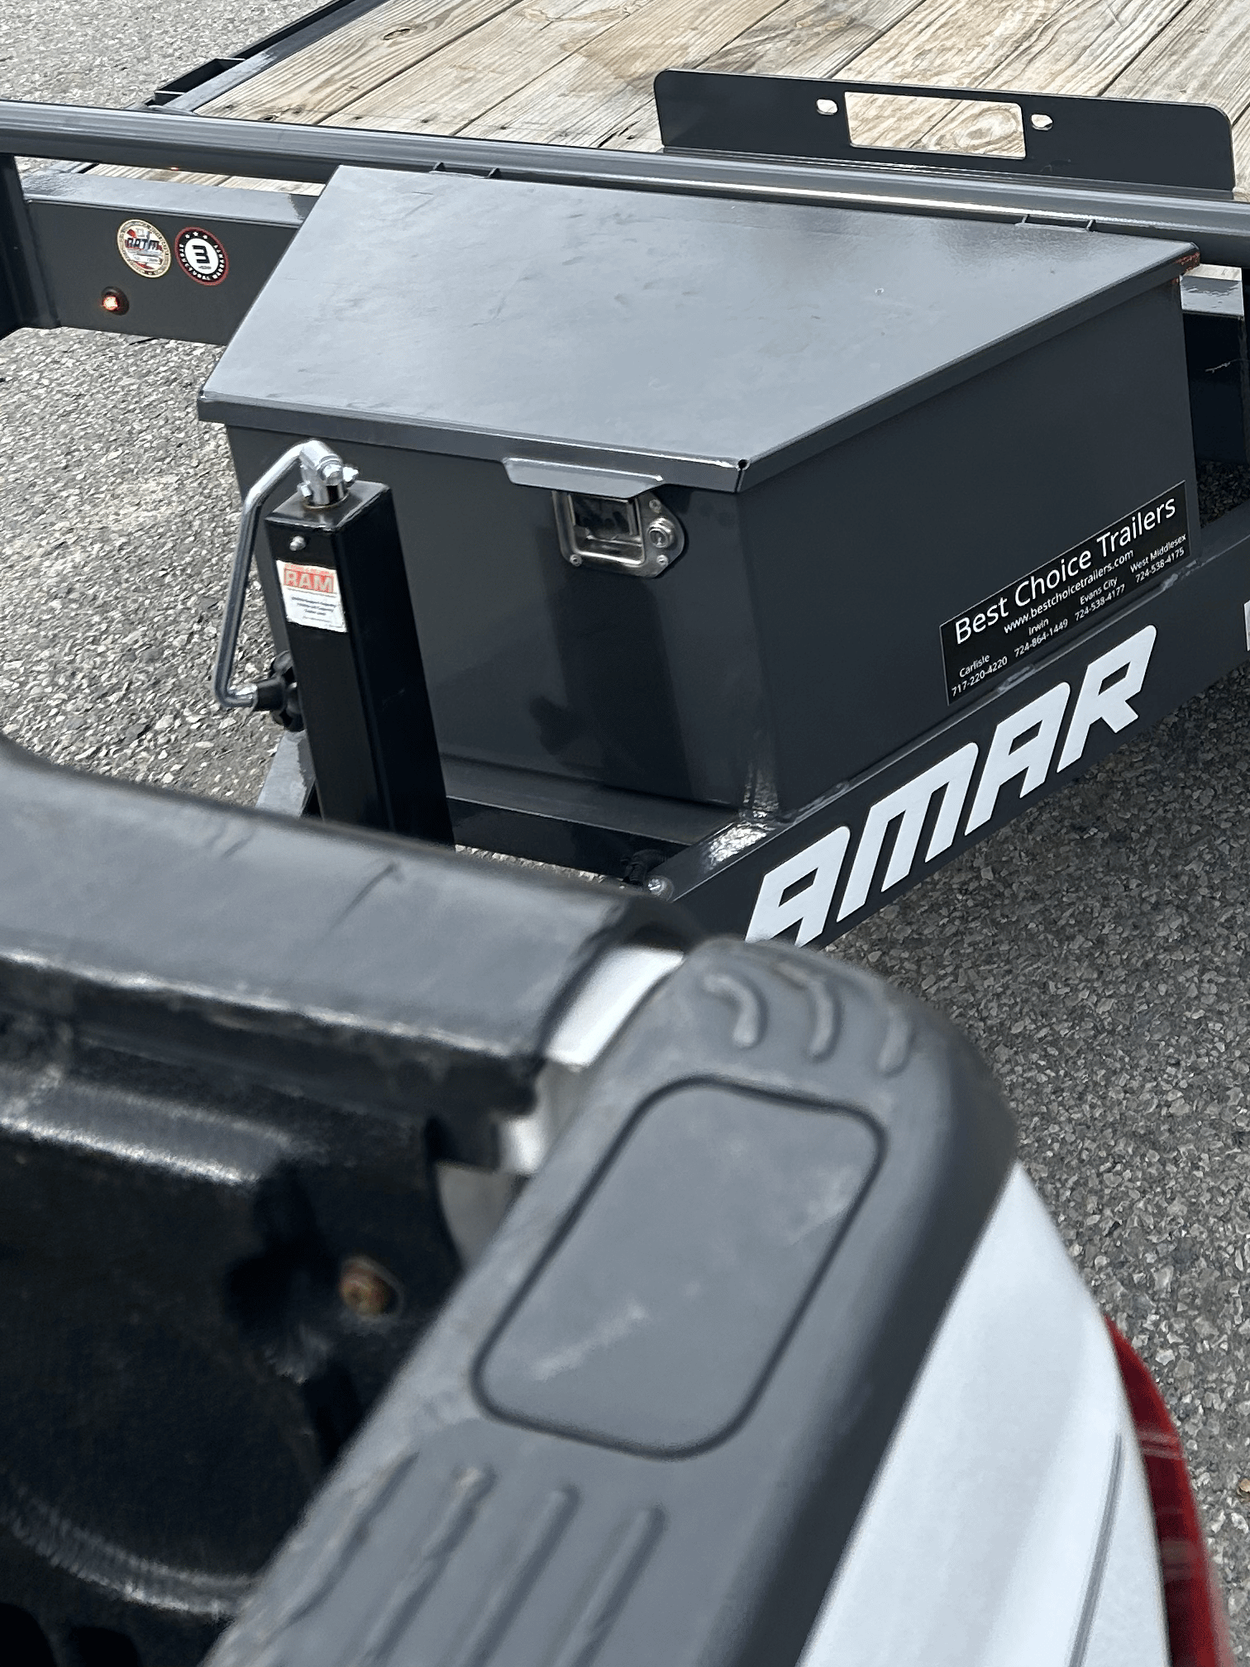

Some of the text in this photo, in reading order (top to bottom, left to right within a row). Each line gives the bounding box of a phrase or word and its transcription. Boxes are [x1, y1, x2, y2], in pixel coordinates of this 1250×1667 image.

[192, 245, 210, 264] 3
[954, 497, 1177, 645] Best Choice Trailers
[1129, 534, 1187, 574] West Middlesex
[1135, 547, 1185, 583] 724-538-4175
[286, 570, 334, 593] RAM
[1003, 549, 1135, 634] www.bestchoicetrailers.com
[1079, 576, 1119, 605] Evans City
[1074, 583, 1126, 622] 724-538-4177
[1013, 618, 1069, 657] 724-864-1449
[1028, 617, 1050, 636] Irwin
[951, 656, 1009, 697] 717-220-4220
[959, 653, 991, 678] Carlisle
[744, 625, 1157, 948] AMAR
